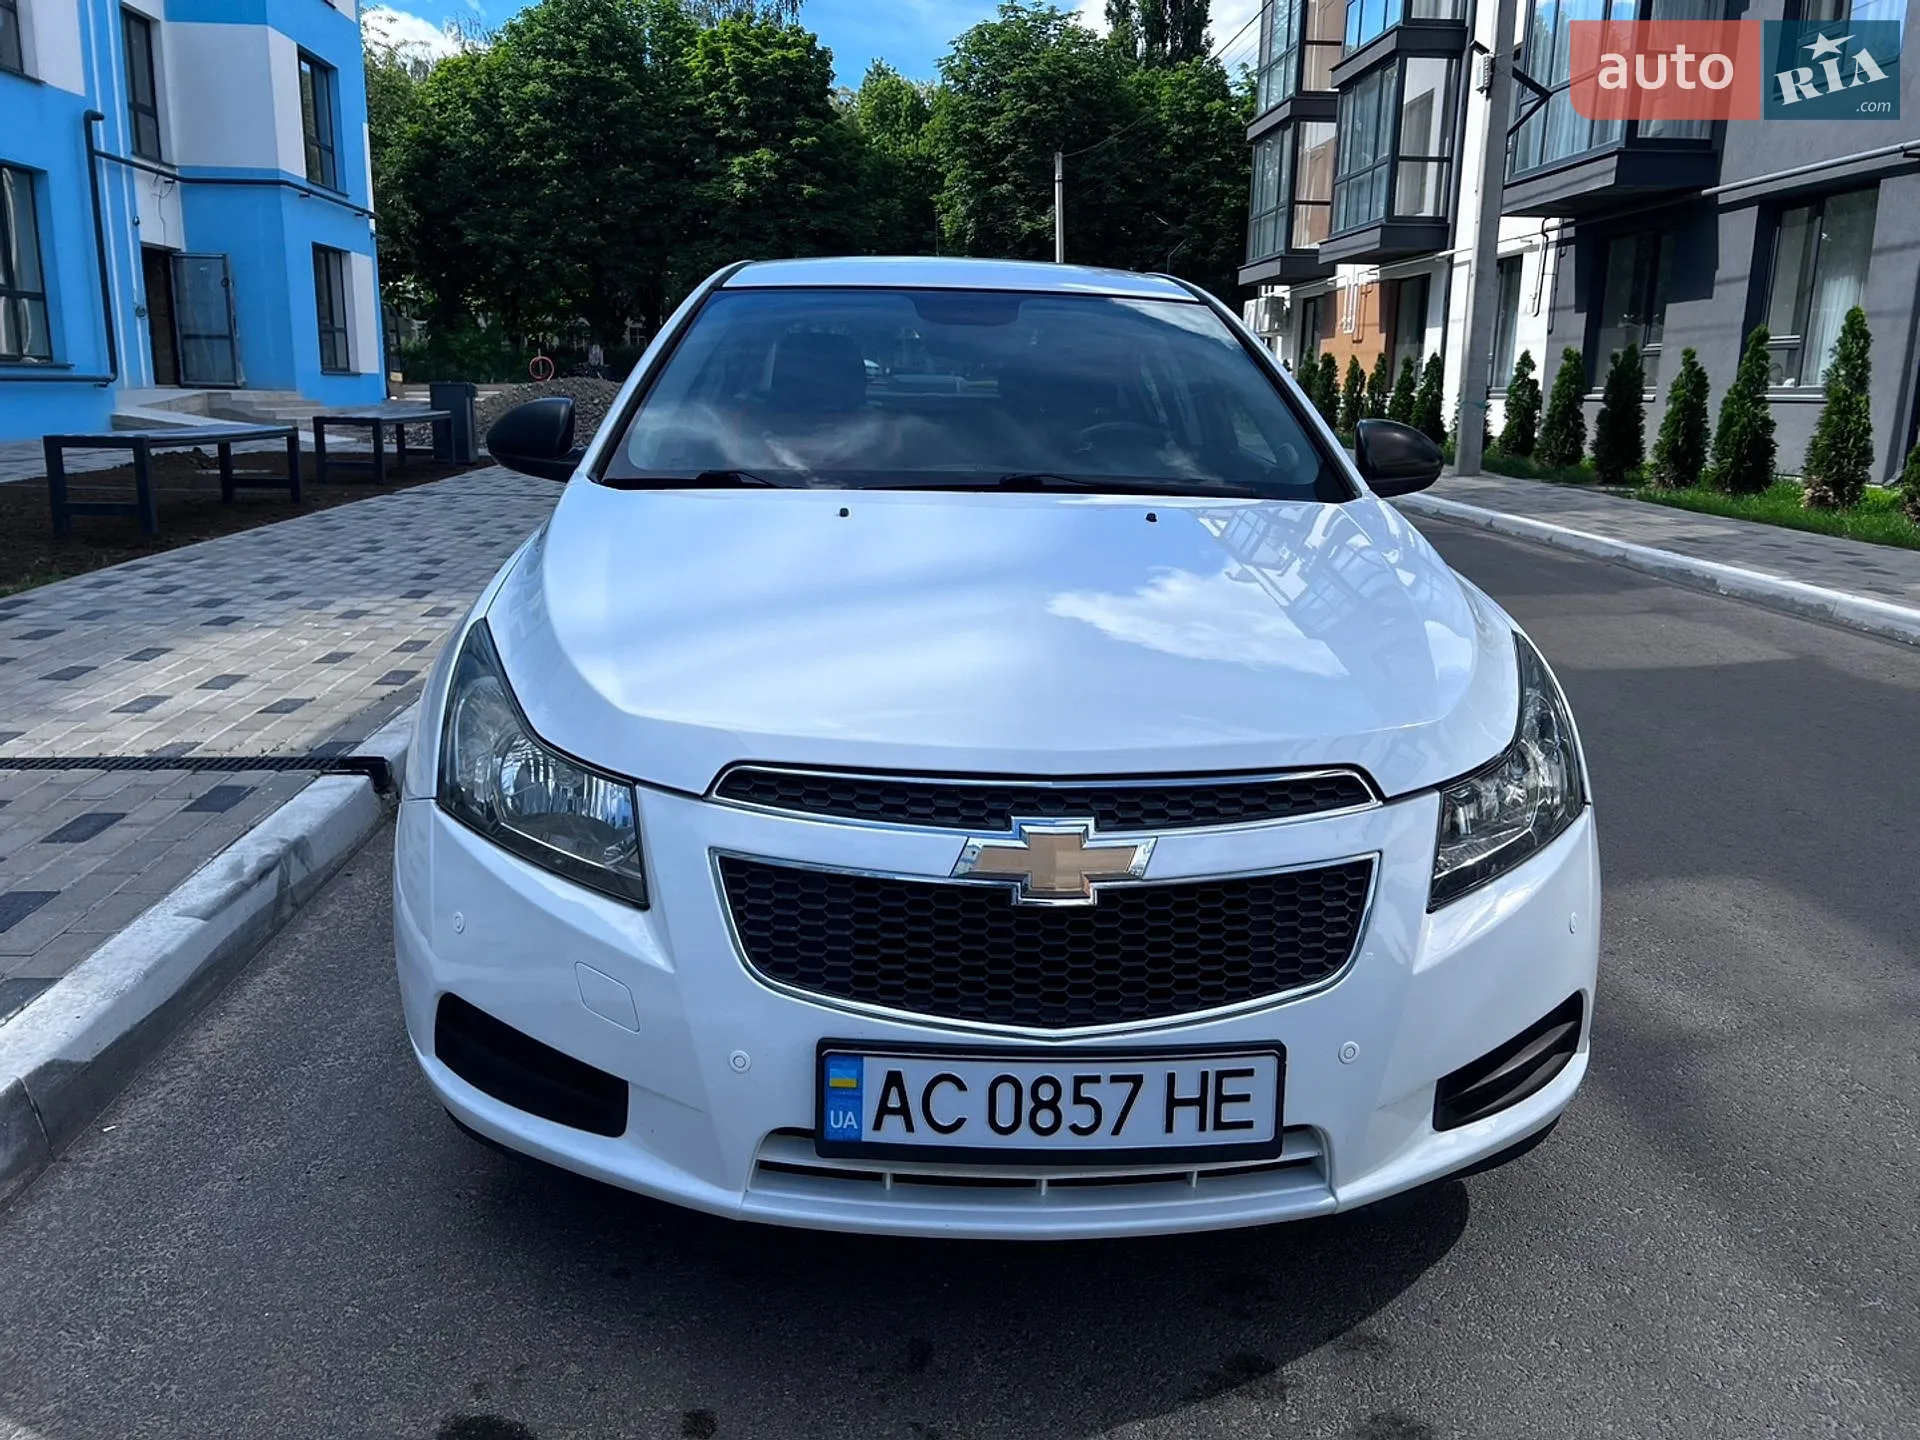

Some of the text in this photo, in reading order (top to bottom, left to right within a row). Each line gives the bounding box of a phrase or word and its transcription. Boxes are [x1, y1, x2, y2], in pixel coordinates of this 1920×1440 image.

[829, 1109, 858, 1130] UA
[871, 1067, 1256, 1137] AC 0857 HE
